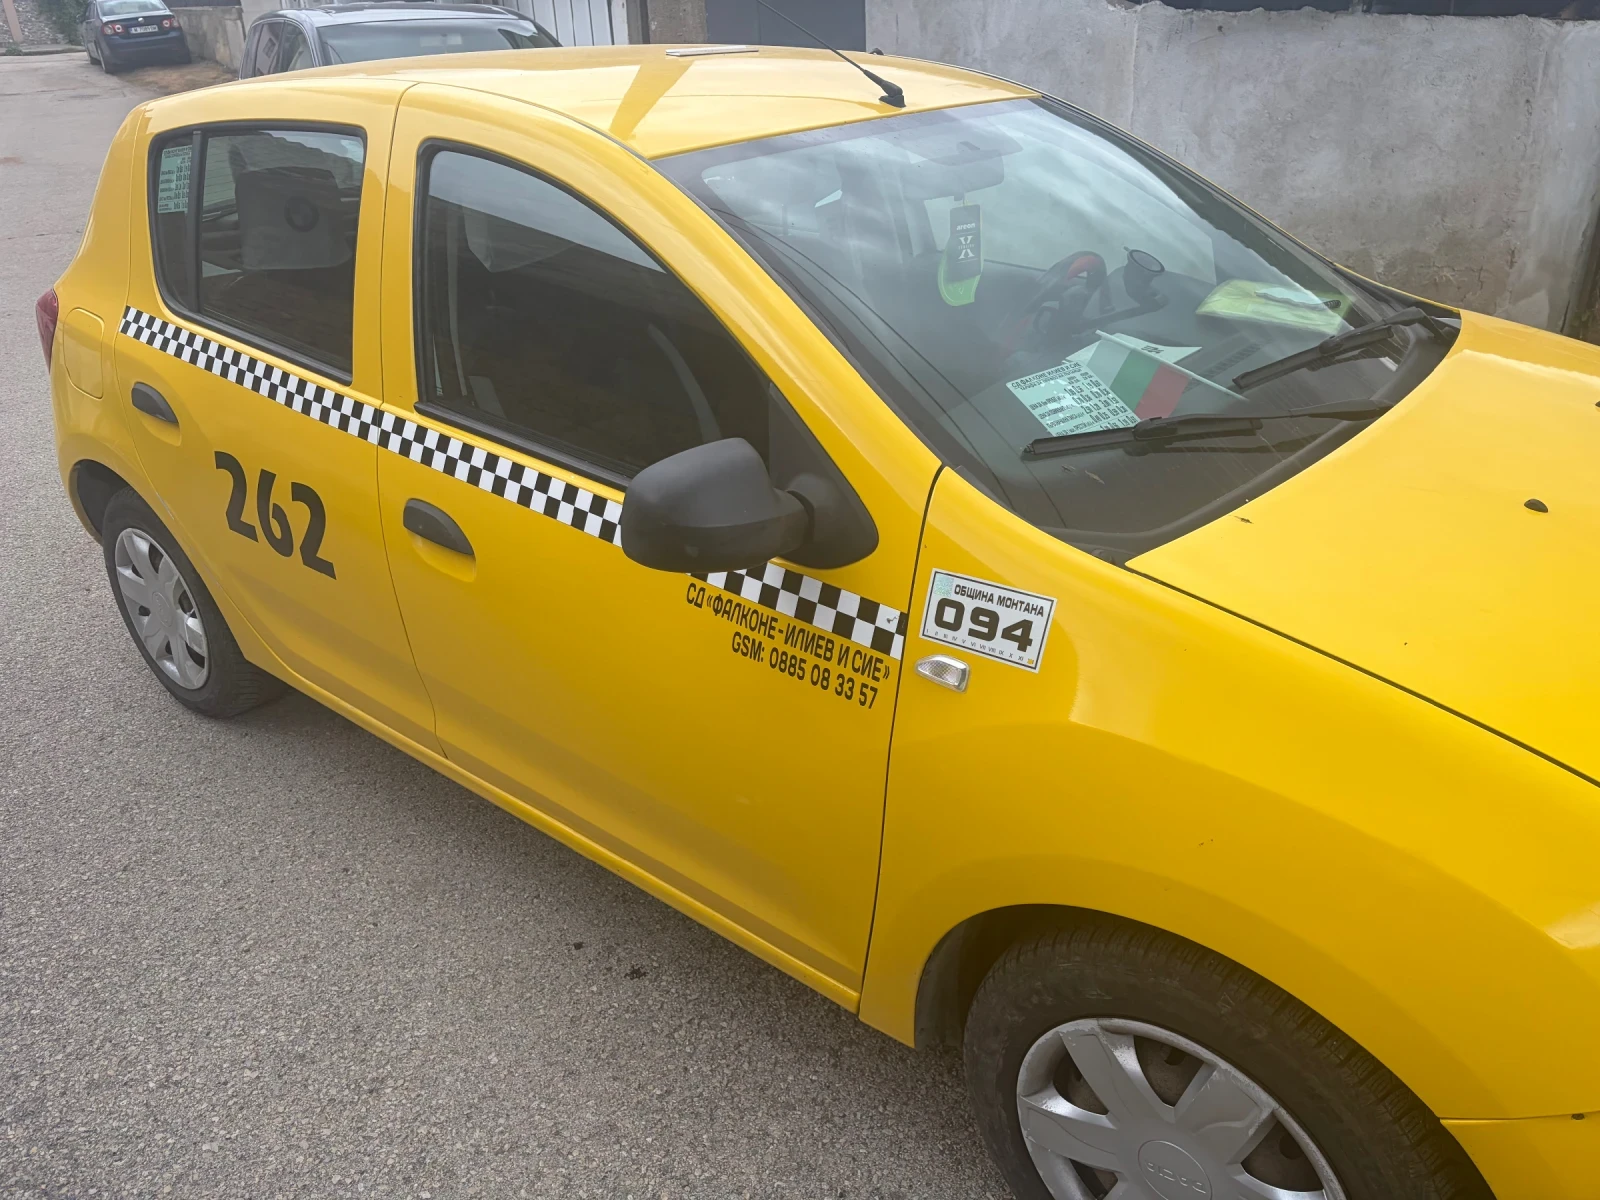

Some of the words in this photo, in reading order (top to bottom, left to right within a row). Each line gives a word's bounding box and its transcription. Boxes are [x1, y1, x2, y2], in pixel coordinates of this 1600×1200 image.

[214, 450, 337, 580] 262
[686, 582, 706, 609] СД
[837, 643, 851, 668] И
[934, 598, 1034, 653] 094
[954, 584, 994, 604] ОБЩИНА
[996, 595, 1044, 617] МОНТАНА
[731, 631, 765, 662] GSM:
[769, 647, 807, 681] 0885
[810, 664, 831, 690] 08
[835, 673, 855, 700] 33
[858, 682, 878, 710] 57
